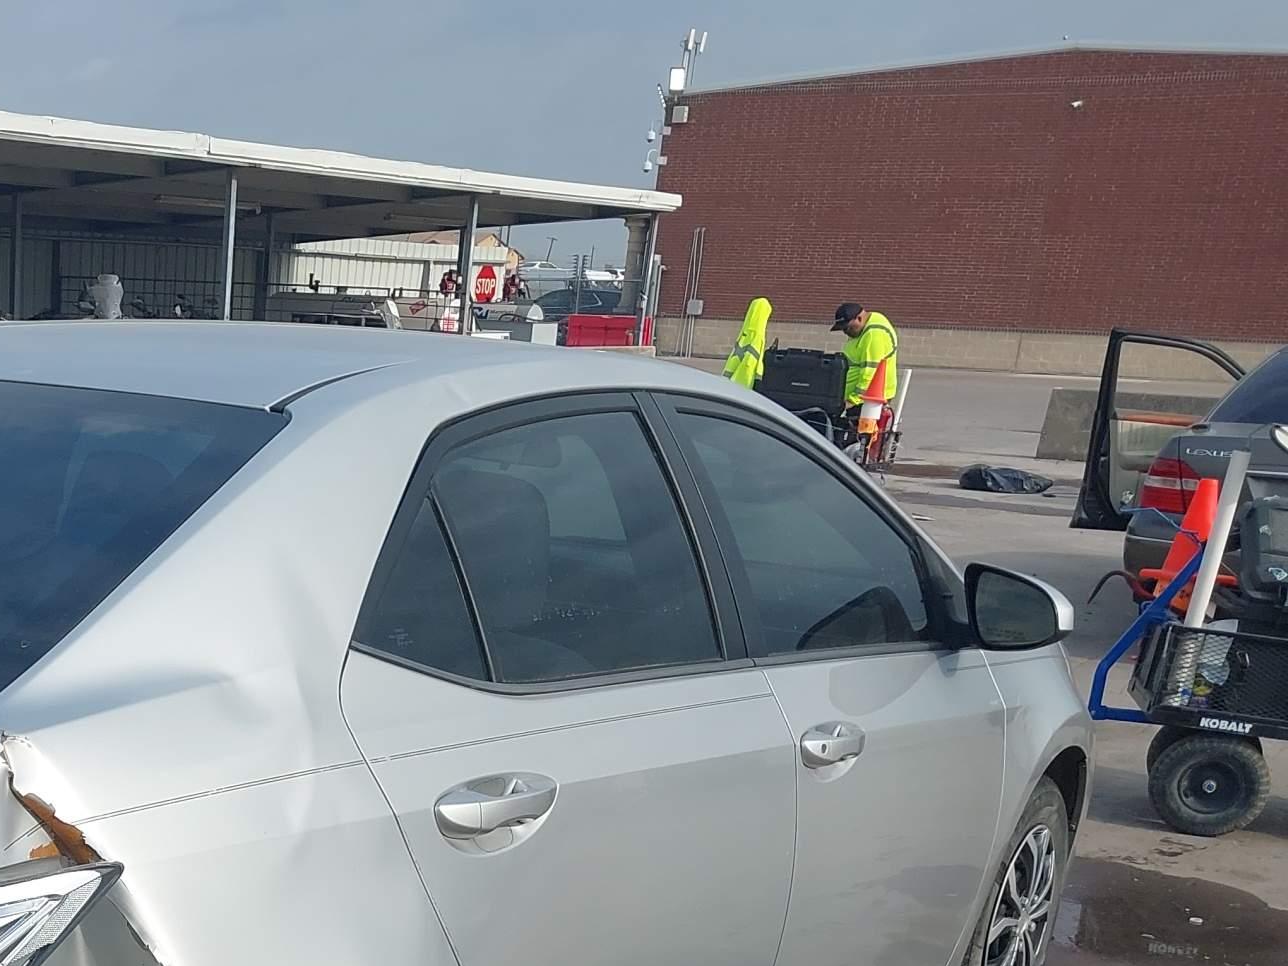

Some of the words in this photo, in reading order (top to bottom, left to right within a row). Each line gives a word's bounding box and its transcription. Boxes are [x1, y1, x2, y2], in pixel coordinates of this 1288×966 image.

[475, 278, 496, 295] STOP
[1185, 447, 1233, 458] LEXUS
[1199, 716, 1253, 734] KOBALT
